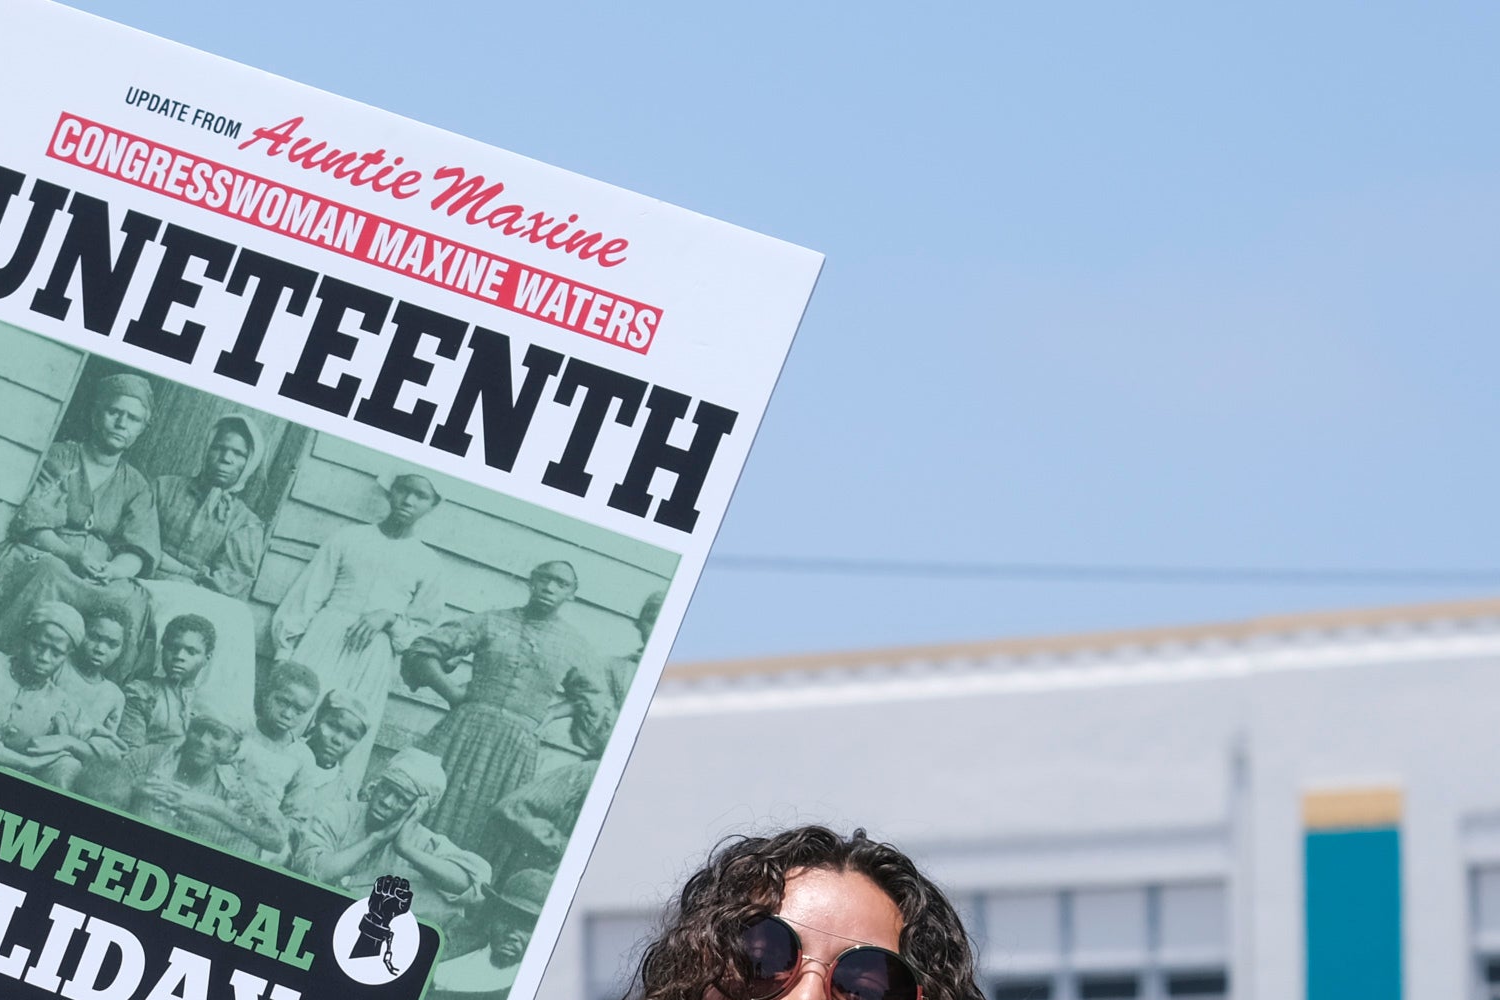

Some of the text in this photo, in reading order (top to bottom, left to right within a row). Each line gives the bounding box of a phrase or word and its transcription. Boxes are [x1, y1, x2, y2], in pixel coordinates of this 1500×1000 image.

[53, 118, 656, 348] CONGRESSWOMAN MAXINE WATERS
[125, 86, 628, 267] UPDATE FROM Auntie Maxine
[54, 835, 314, 971] FEDERAL
